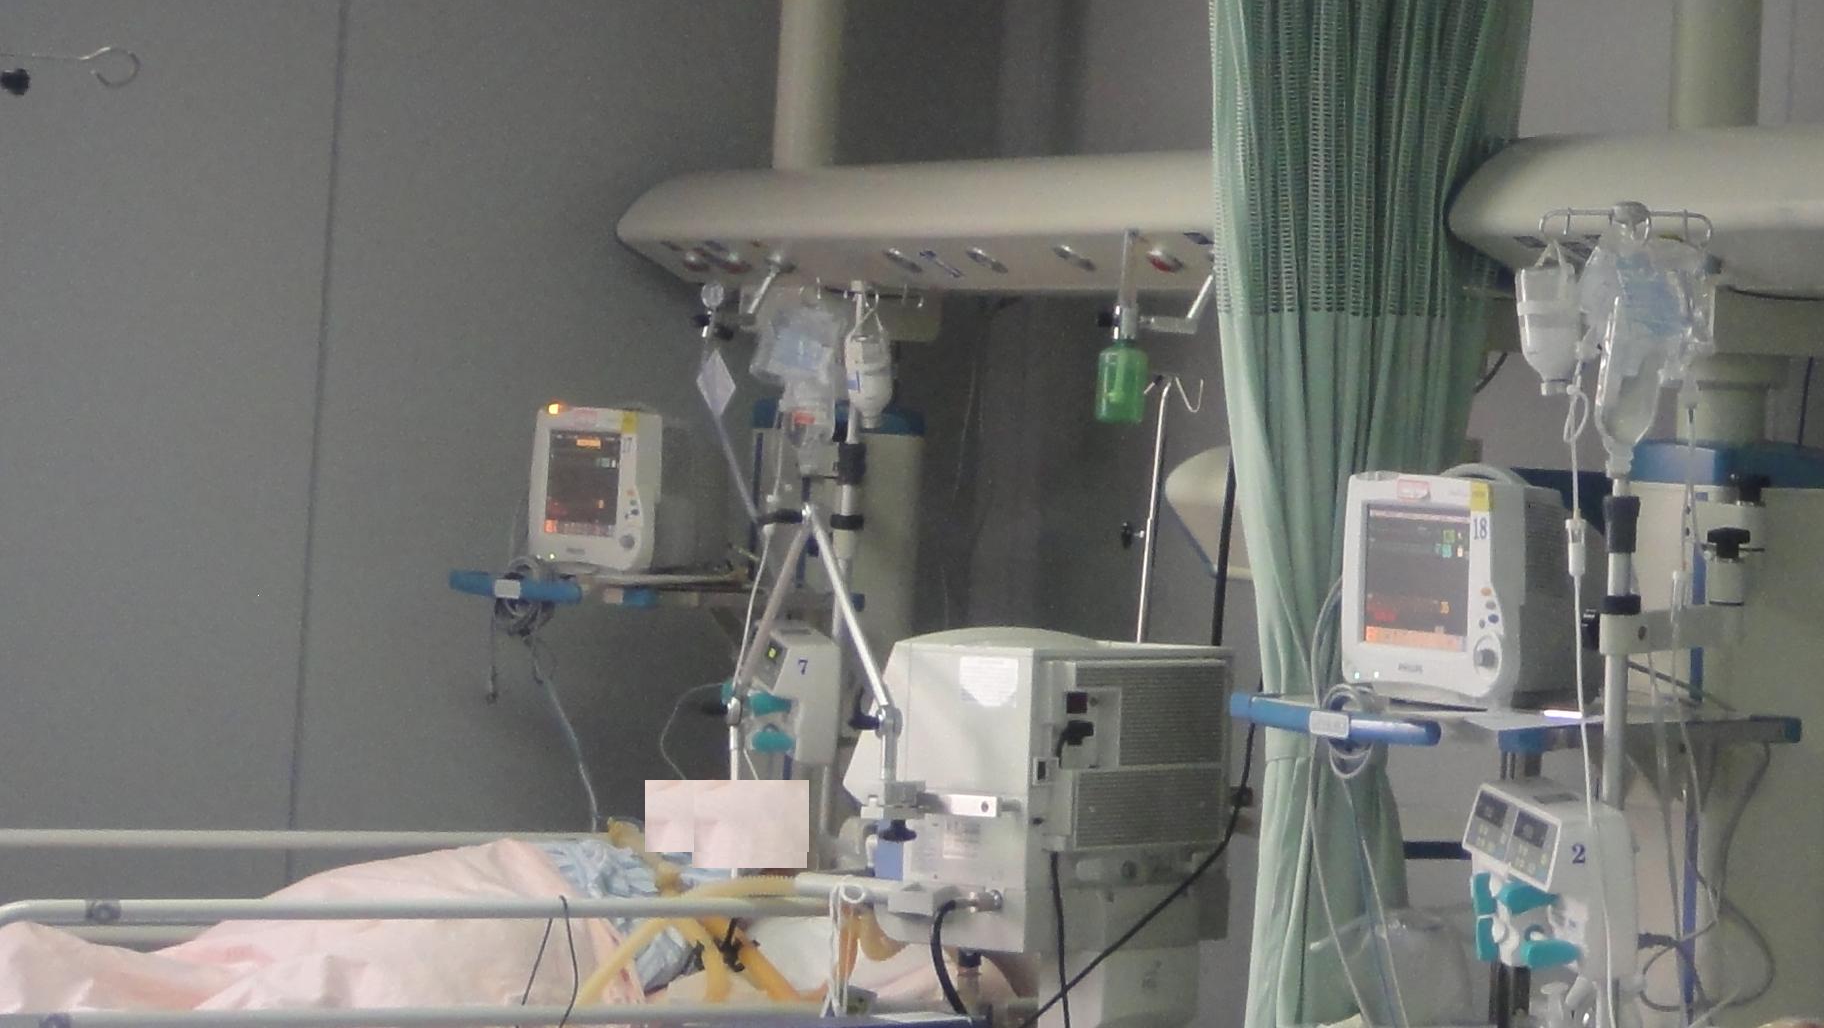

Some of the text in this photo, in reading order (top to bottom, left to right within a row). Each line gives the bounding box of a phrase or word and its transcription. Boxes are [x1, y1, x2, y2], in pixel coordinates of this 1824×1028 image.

[1473, 517, 1488, 540] 18
[798, 659, 809, 675] 7
[1571, 844, 1586, 864] 2
